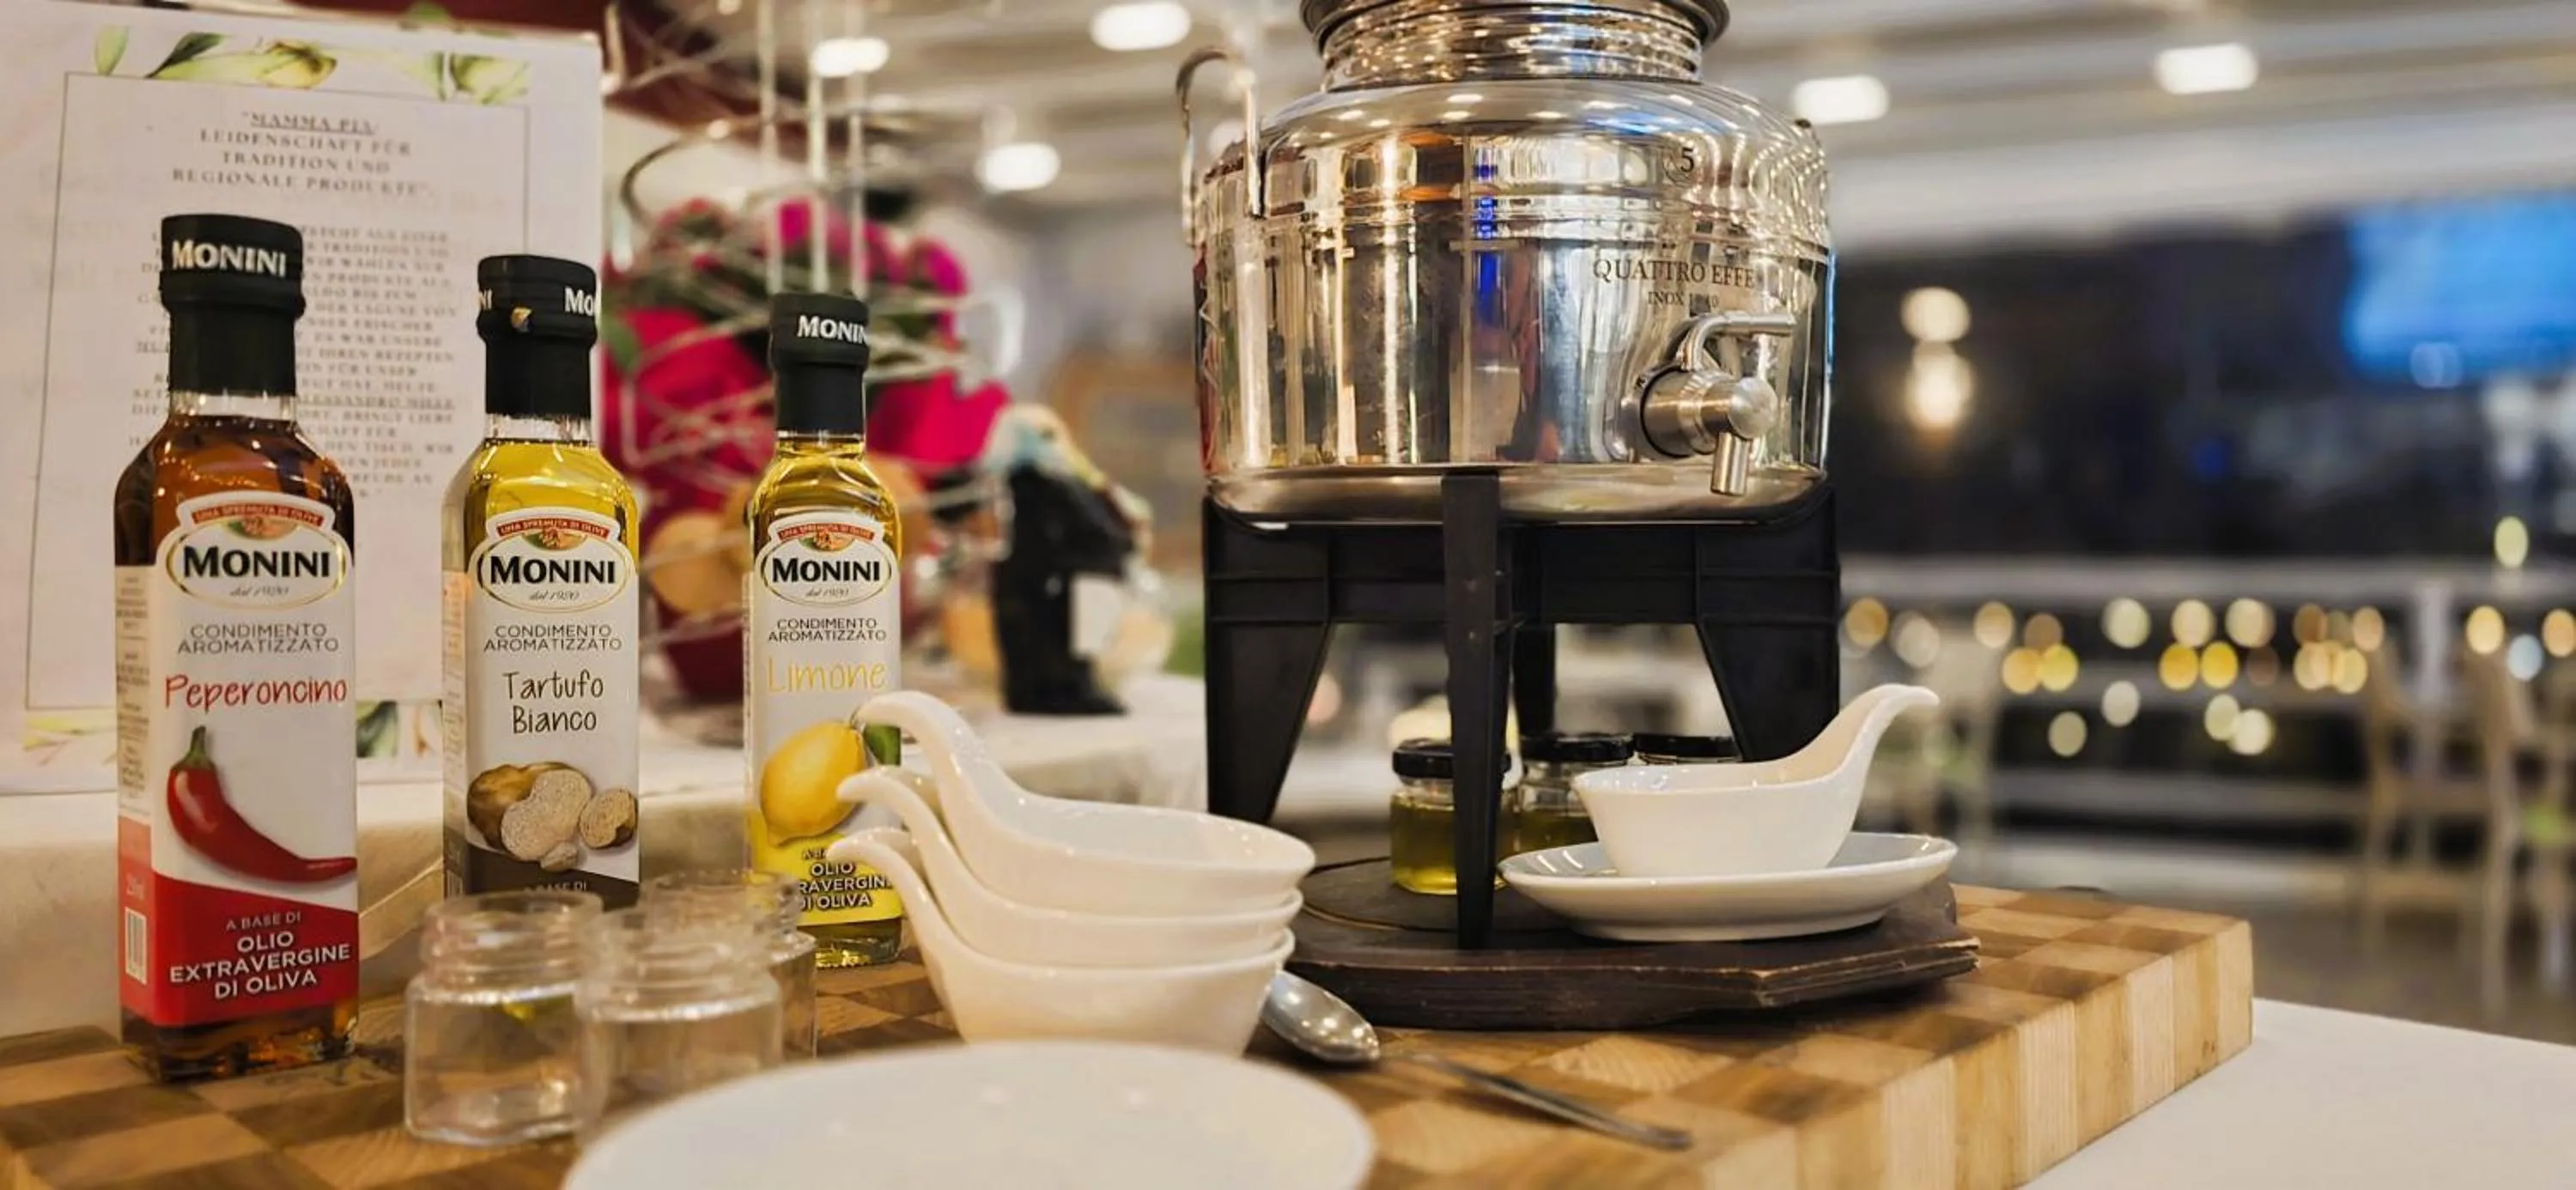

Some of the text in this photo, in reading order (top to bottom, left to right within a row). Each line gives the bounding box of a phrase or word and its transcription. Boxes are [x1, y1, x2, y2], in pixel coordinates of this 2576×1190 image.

[199, 127, 362, 153] LEIDENSCHAFT
[222, 150, 339, 172] TRADITION
[172, 167, 299, 188] REGIONALE
[172, 240, 287, 277] MONINI
[1593, 258, 1754, 288] QUATTRO EFFE
[1648, 291, 1684, 306] INOX
[797, 314, 866, 344] MONIN
[183, 545, 331, 578] MONINI
[489, 556, 616, 584] MONINI
[773, 557, 881, 583] MONINI
[190, 622, 328, 641] CONDIMENTO
[495, 623, 612, 639] CONDIMENTO
[768, 629, 887, 643] AROMATIZZATO
[776, 617, 878, 630] CONDIMENTO
[177, 638, 339, 654] AROMATIZZATO
[483, 638, 623, 653] AROMATIZZATO
[501, 667, 605, 701] Tartufo
[767, 656, 887, 694] Limone
[163, 673, 348, 713] Peperoncino
[512, 705, 597, 734] Bianco
[810, 861, 855, 877] OLIO
[817, 893, 872, 909] OLIVA
[225, 911, 301, 932] A BASE DI
[236, 930, 295, 954] OLIO
[169, 943, 351, 984] EXTRAVERGINE
[215, 968, 318, 1000] DI OLIVA
